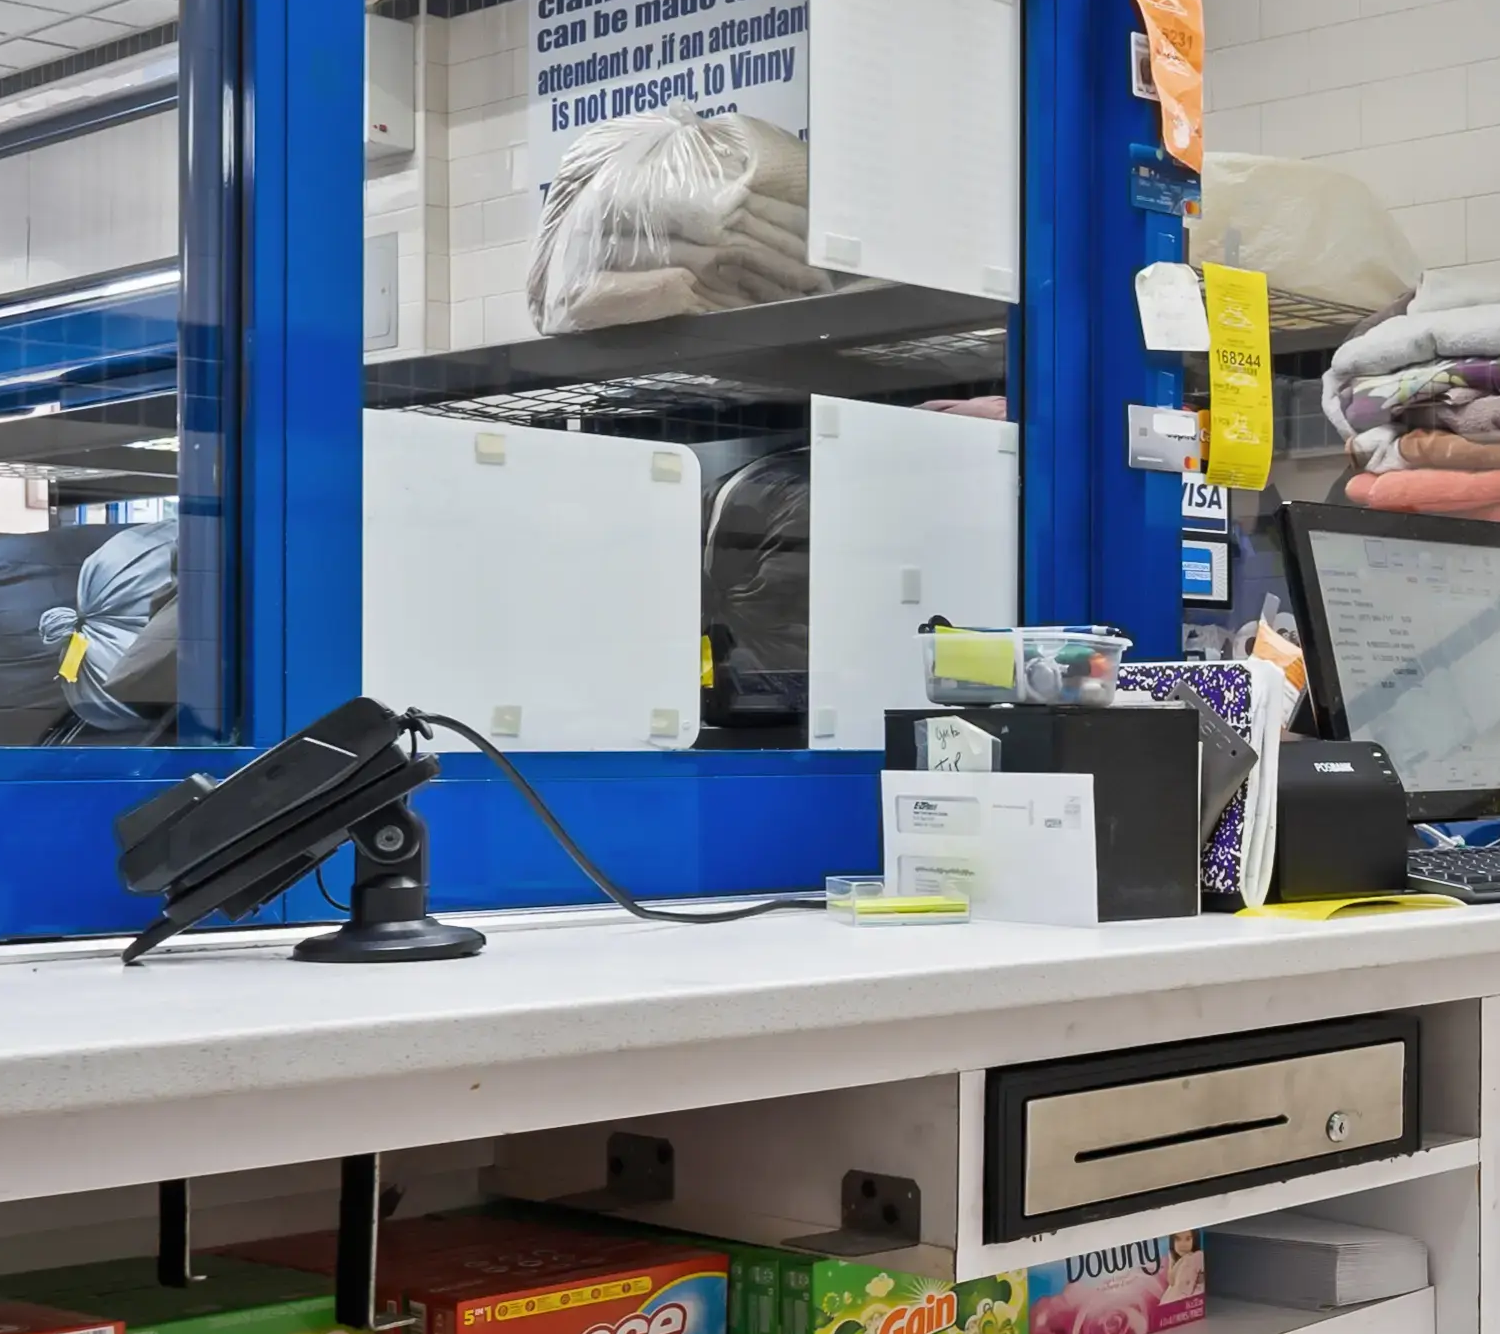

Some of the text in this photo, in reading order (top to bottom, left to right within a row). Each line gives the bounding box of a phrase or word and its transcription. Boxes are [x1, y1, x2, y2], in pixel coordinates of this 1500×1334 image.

[537, 18, 586, 53] can
[594, 8, 628, 39] be
[538, 46, 628, 96] attendant
[633, 43, 654, 72] or
[679, 30, 704, 62] an
[708, 1, 808, 53] attendant
[552, 98, 569, 132] is
[574, 88, 607, 127] not
[703, 63, 725, 97] to
[730, 46, 796, 90] Vinny
[1215, 348, 1261, 368] 168244
[463, 1310, 475, 1326] 5
